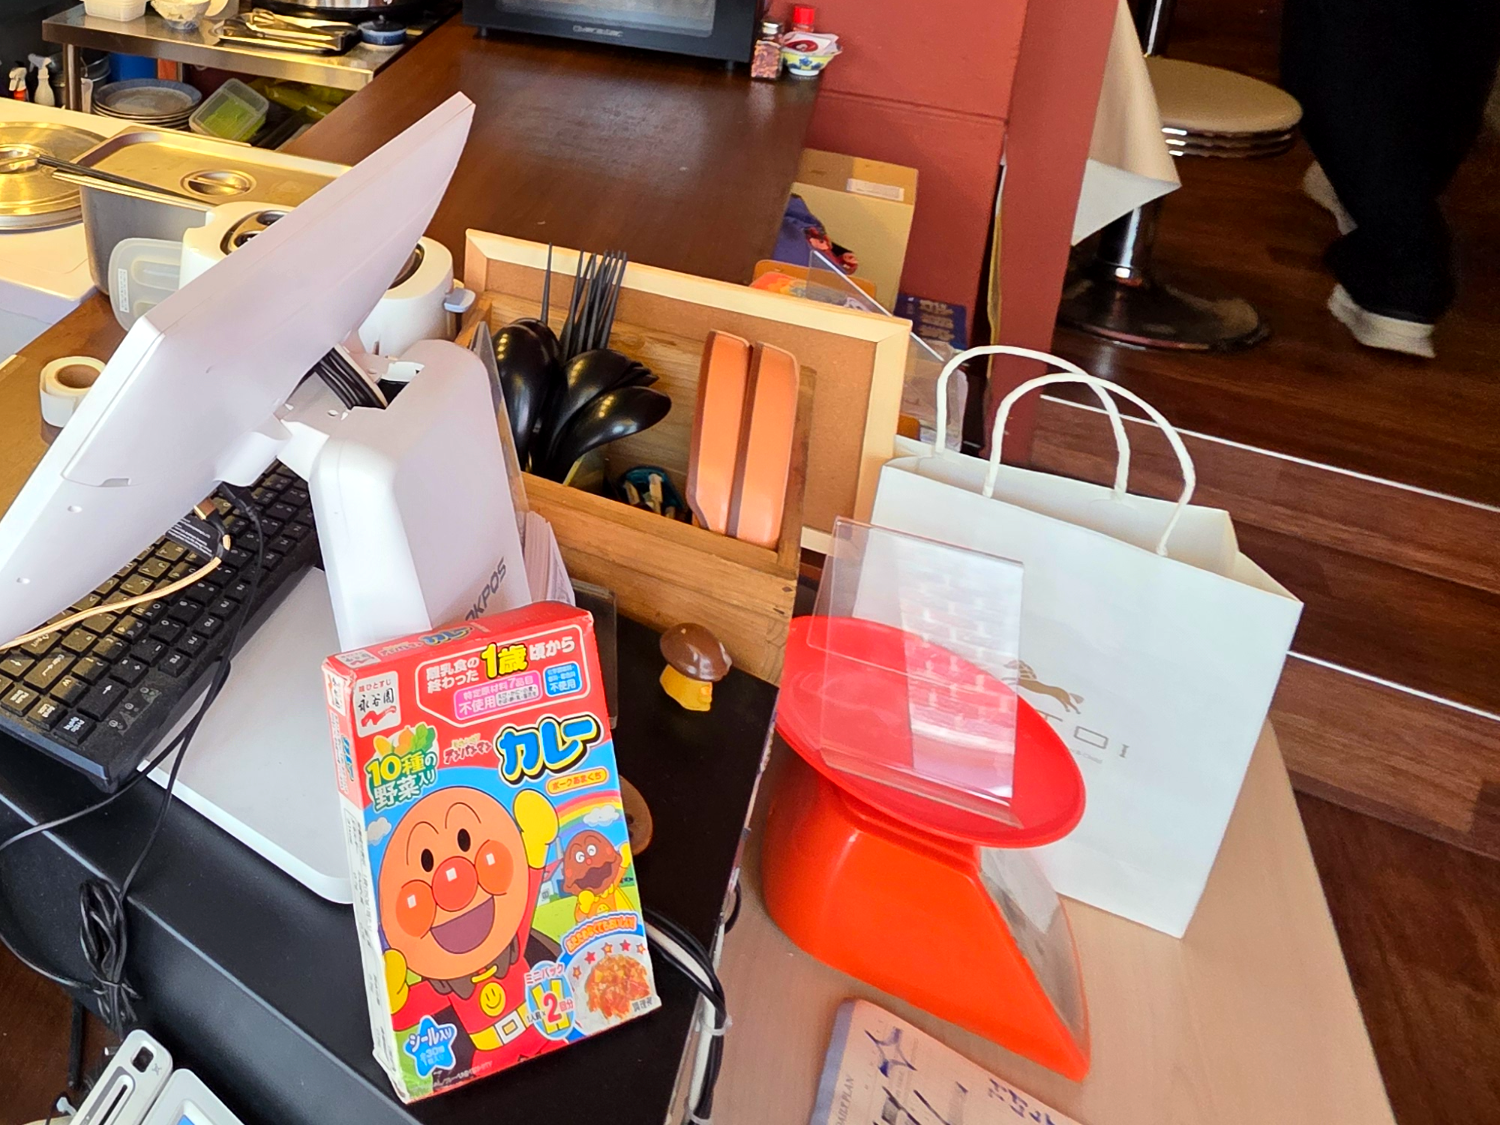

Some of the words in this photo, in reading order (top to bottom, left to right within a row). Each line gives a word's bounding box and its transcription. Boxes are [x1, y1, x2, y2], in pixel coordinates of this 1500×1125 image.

[529, 637, 576, 661] 頃から
[427, 669, 480, 694] 終わった
[550, 680, 577, 693] 不使用
[358, 687, 396, 713] 永谷園
[459, 696, 496, 716] 不使用
[498, 715, 601, 785] カレー
[367, 750, 437, 787] 10種の
[373, 768, 437, 808] 野菜入り
[524, 963, 565, 986] ミニパック
